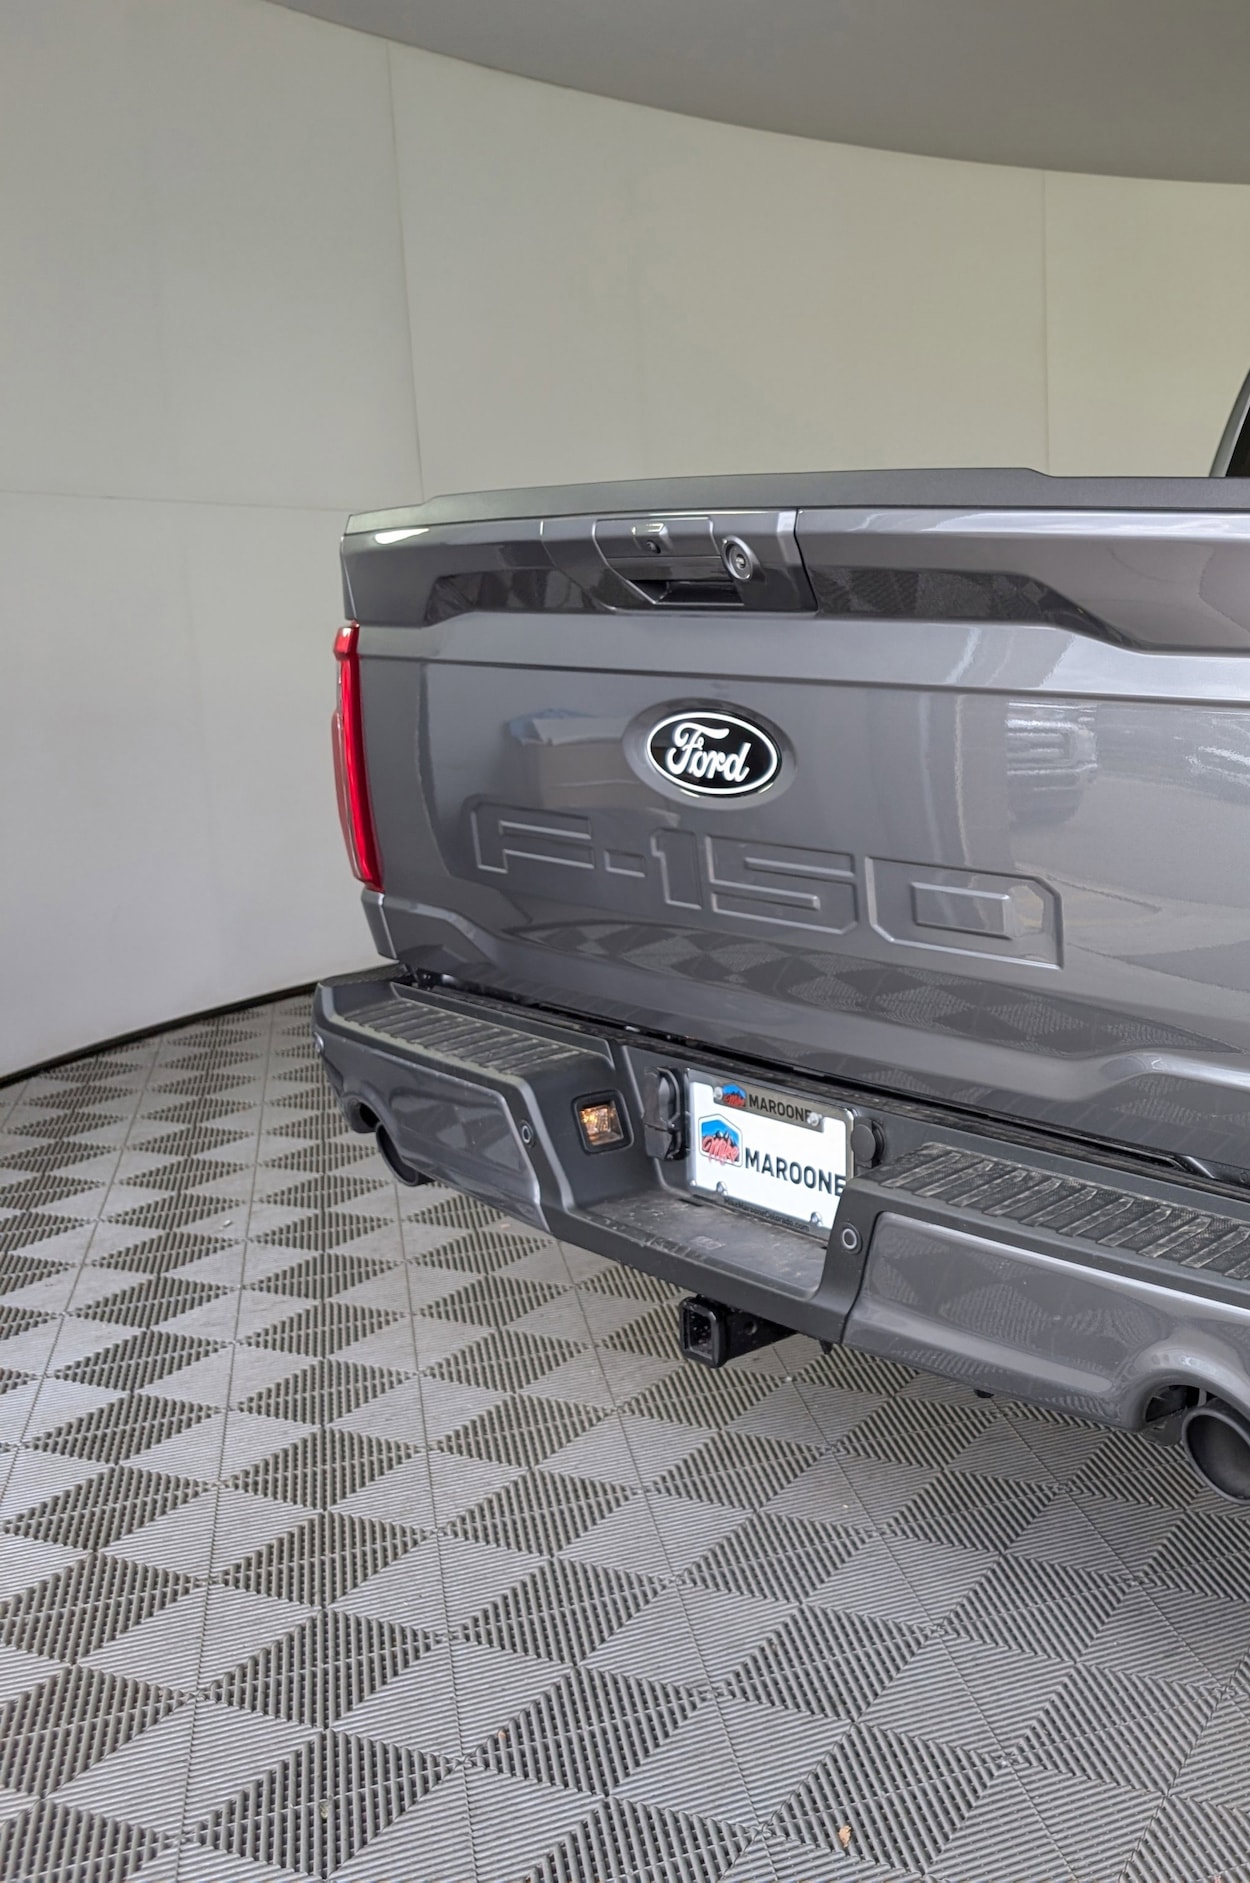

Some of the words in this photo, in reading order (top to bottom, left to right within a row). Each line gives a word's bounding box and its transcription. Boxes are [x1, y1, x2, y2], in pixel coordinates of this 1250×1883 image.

[665, 721, 752, 782] Ford
[470, 802, 1064, 970] F-150
[745, 1147, 847, 1197] MAROONE
